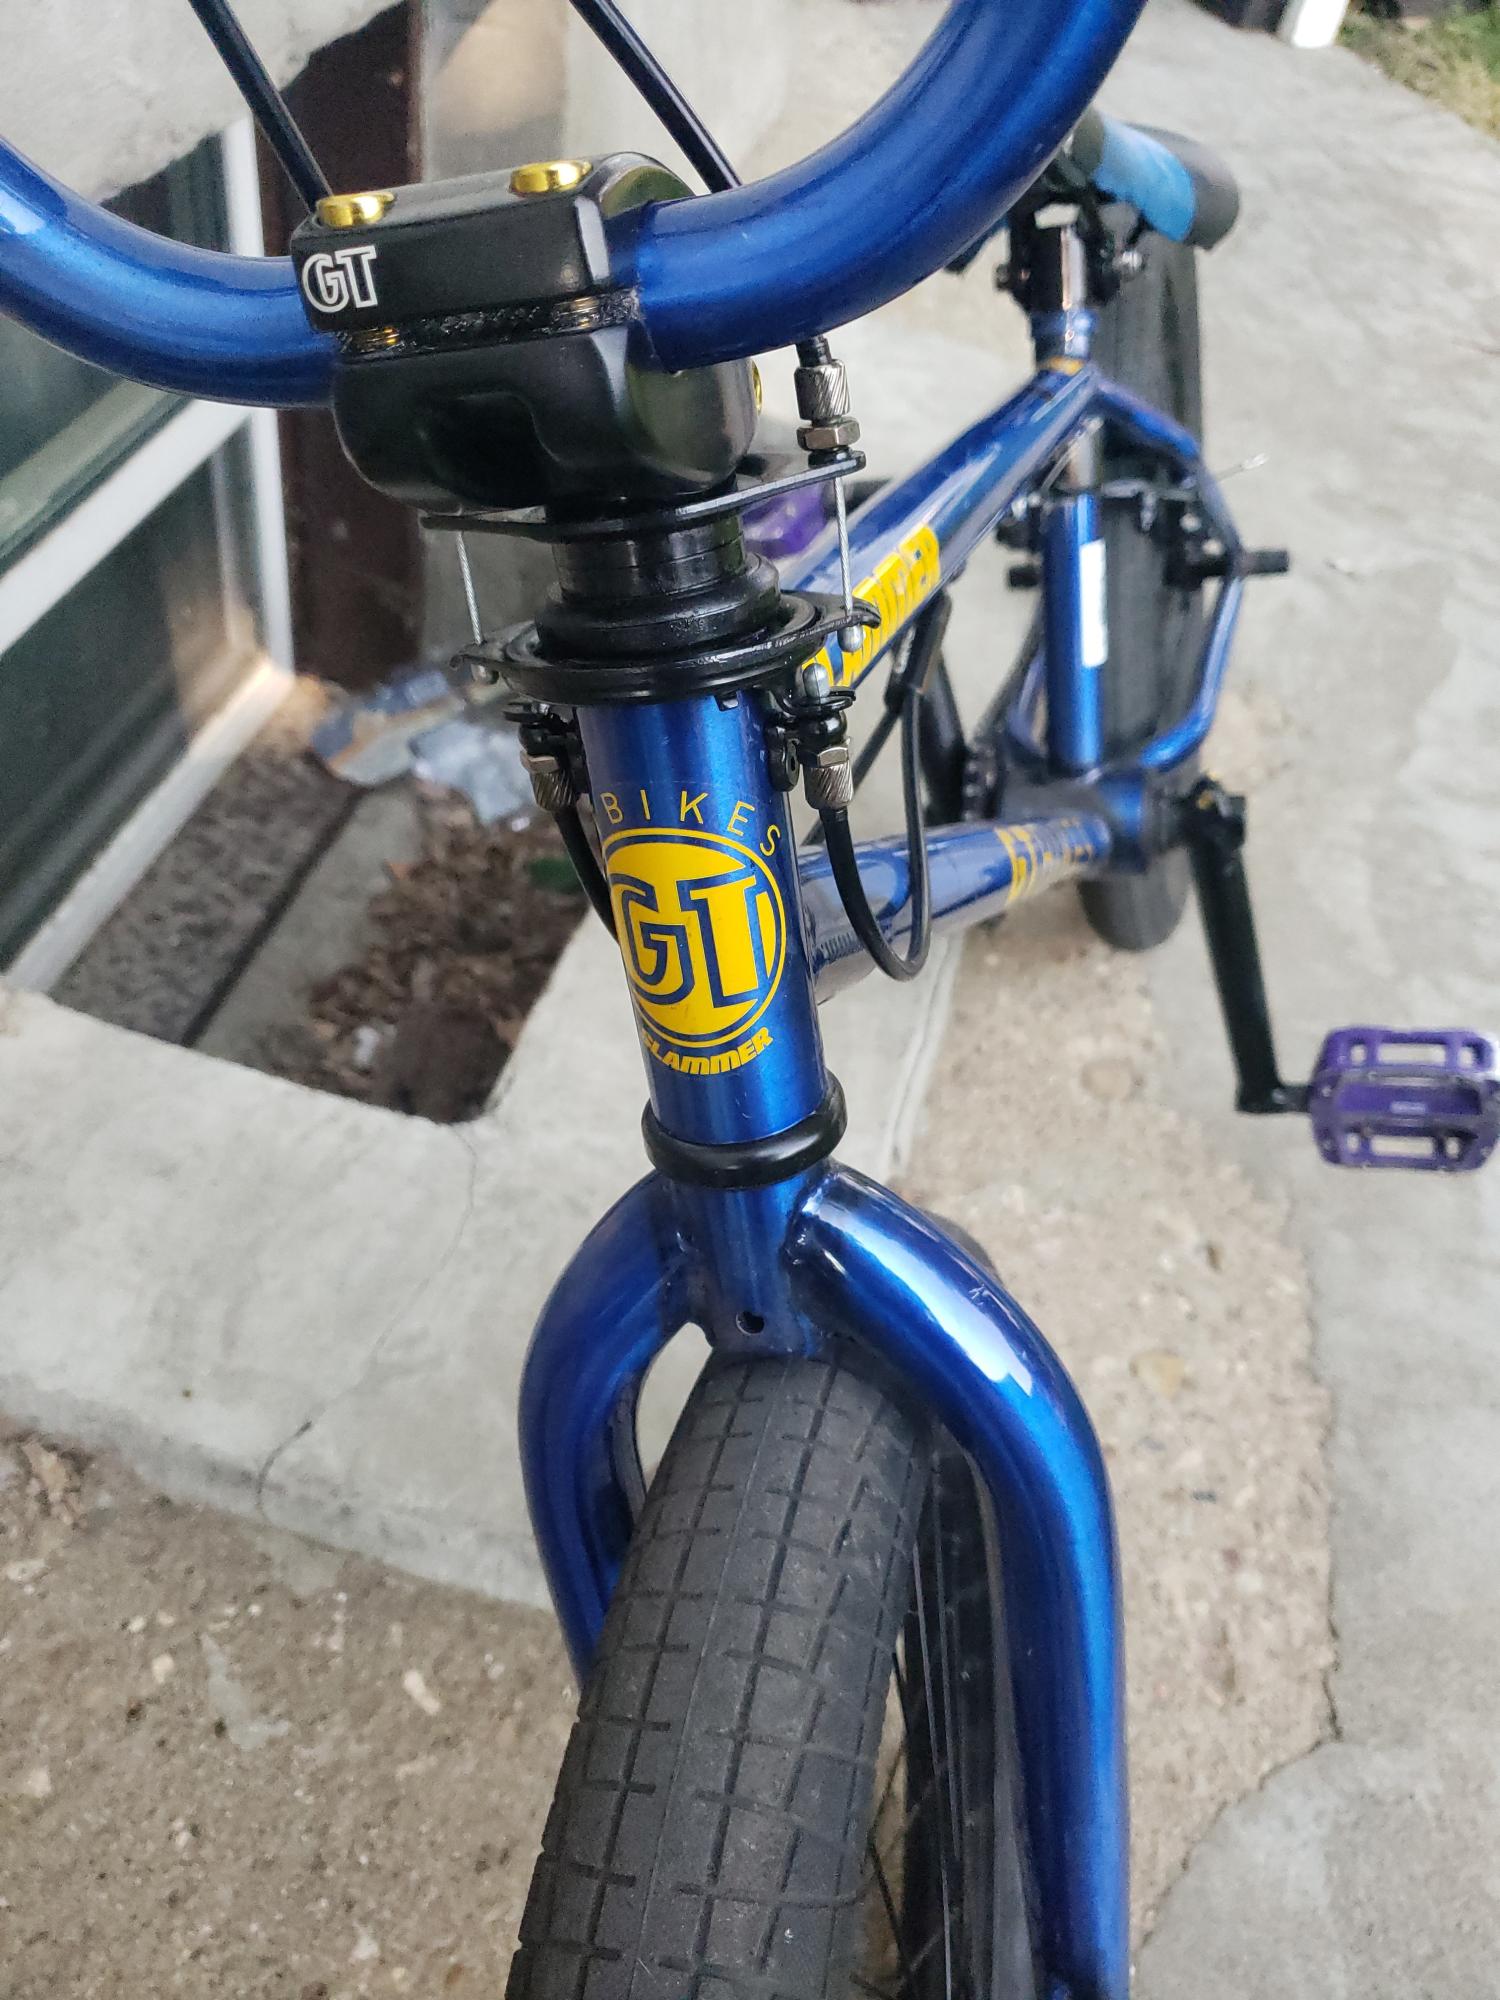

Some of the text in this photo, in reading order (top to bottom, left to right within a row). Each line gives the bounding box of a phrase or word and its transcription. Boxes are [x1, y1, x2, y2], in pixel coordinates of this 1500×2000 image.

[302, 245, 378, 313] GT
[600, 789, 781, 857] BIKES
[609, 870, 760, 1009] GT
